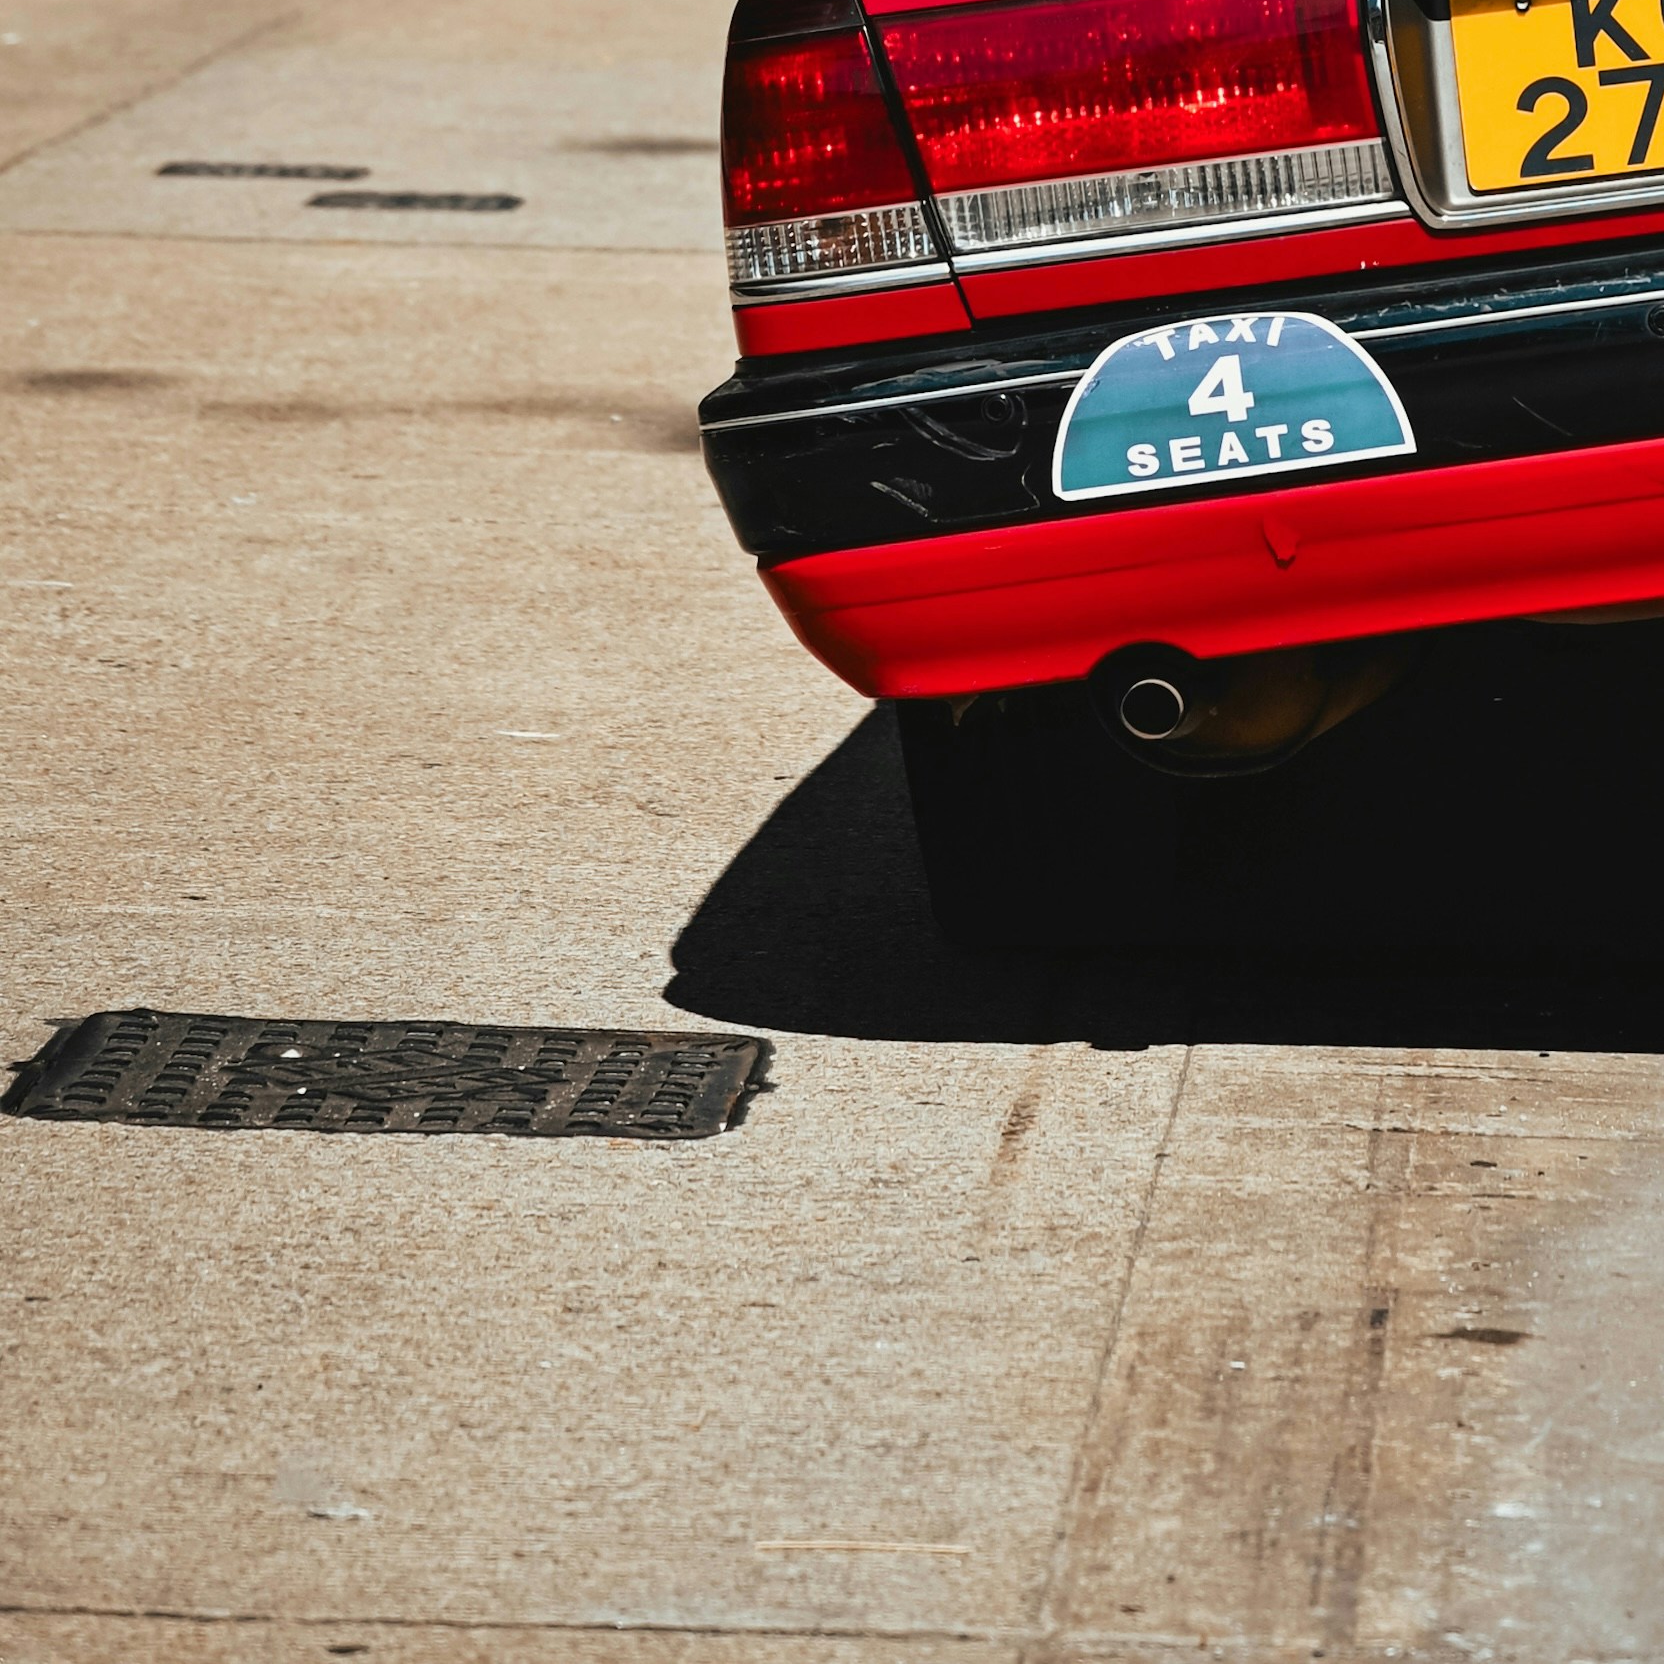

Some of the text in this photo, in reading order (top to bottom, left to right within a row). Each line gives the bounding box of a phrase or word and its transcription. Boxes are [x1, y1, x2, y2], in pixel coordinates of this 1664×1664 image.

[1142, 316, 1285, 361] TAXI
[1187, 353, 1255, 423] 4
[1126, 418, 1335, 478] SEATS
